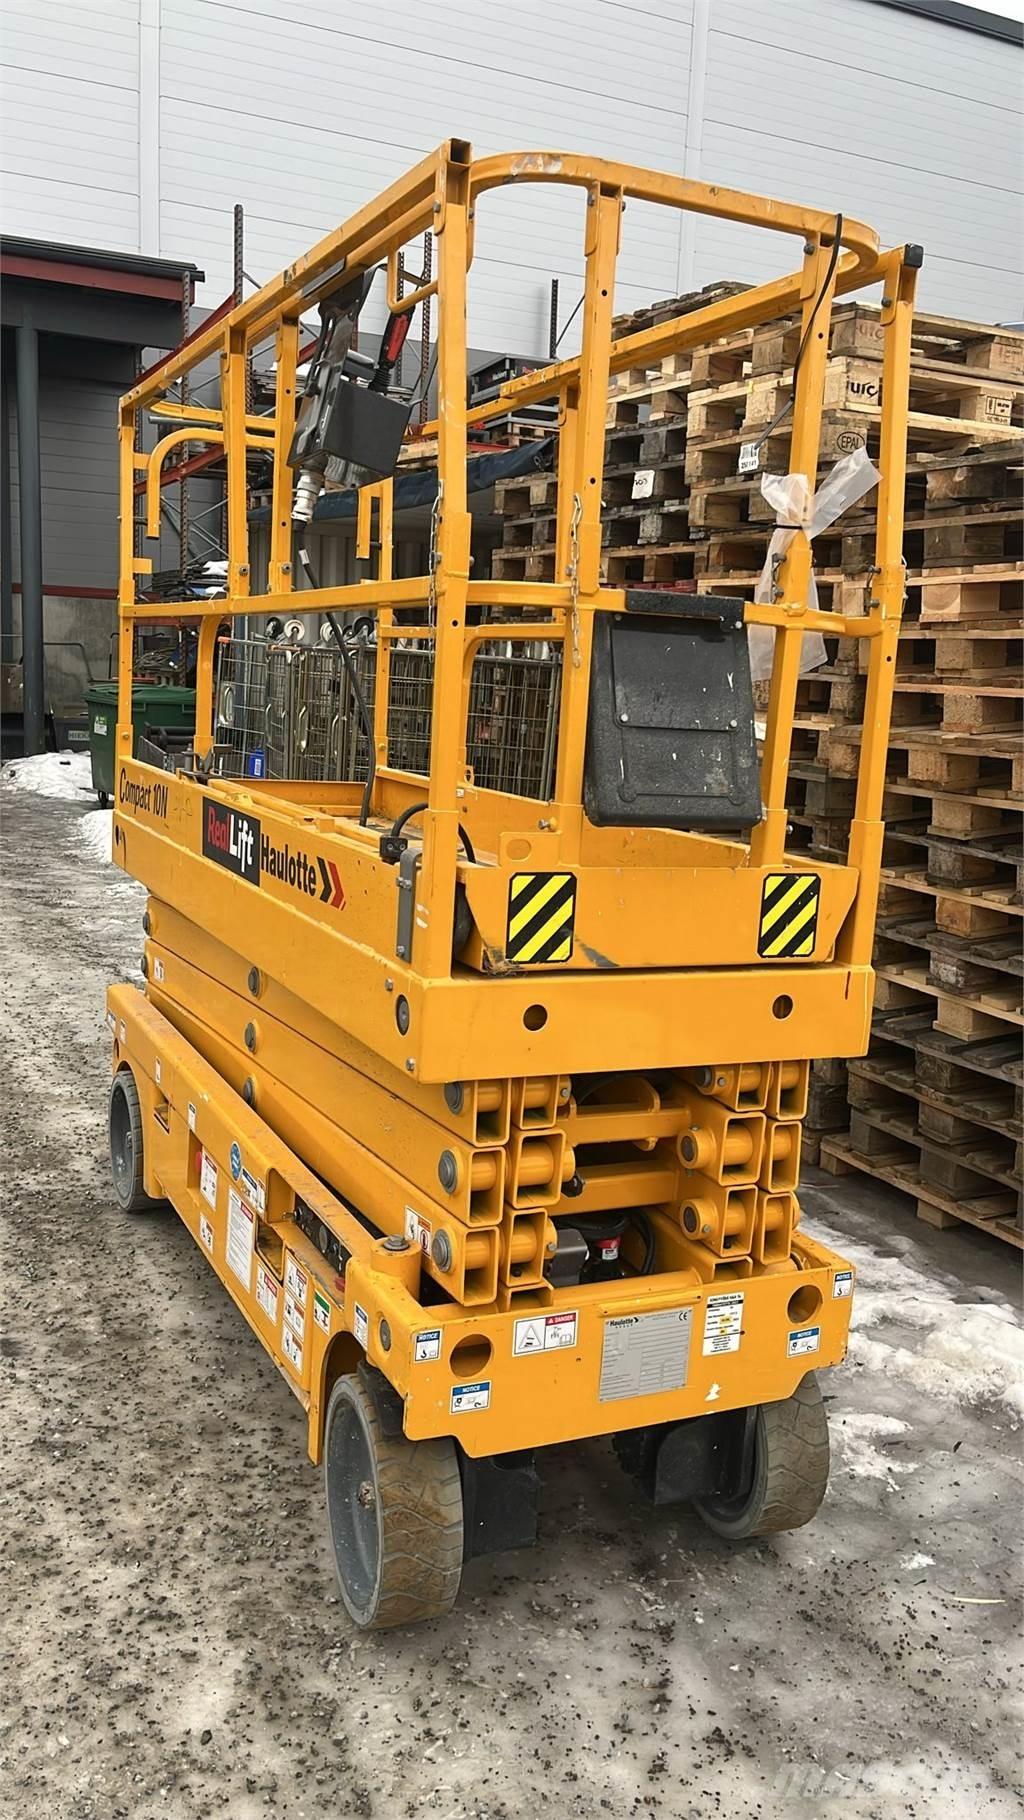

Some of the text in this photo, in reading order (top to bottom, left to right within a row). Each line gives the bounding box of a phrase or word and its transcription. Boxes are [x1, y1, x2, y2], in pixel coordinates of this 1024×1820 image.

[119, 767, 169, 819] Compact 10N
[260, 832, 317, 897] Haulotte
[555, 1314, 574, 1324] DANGER
[609, 1318, 634, 1327] Haulotte
[417, 1332, 439, 1341] NOTICE
[461, 1385, 481, 1393] NOTICE
